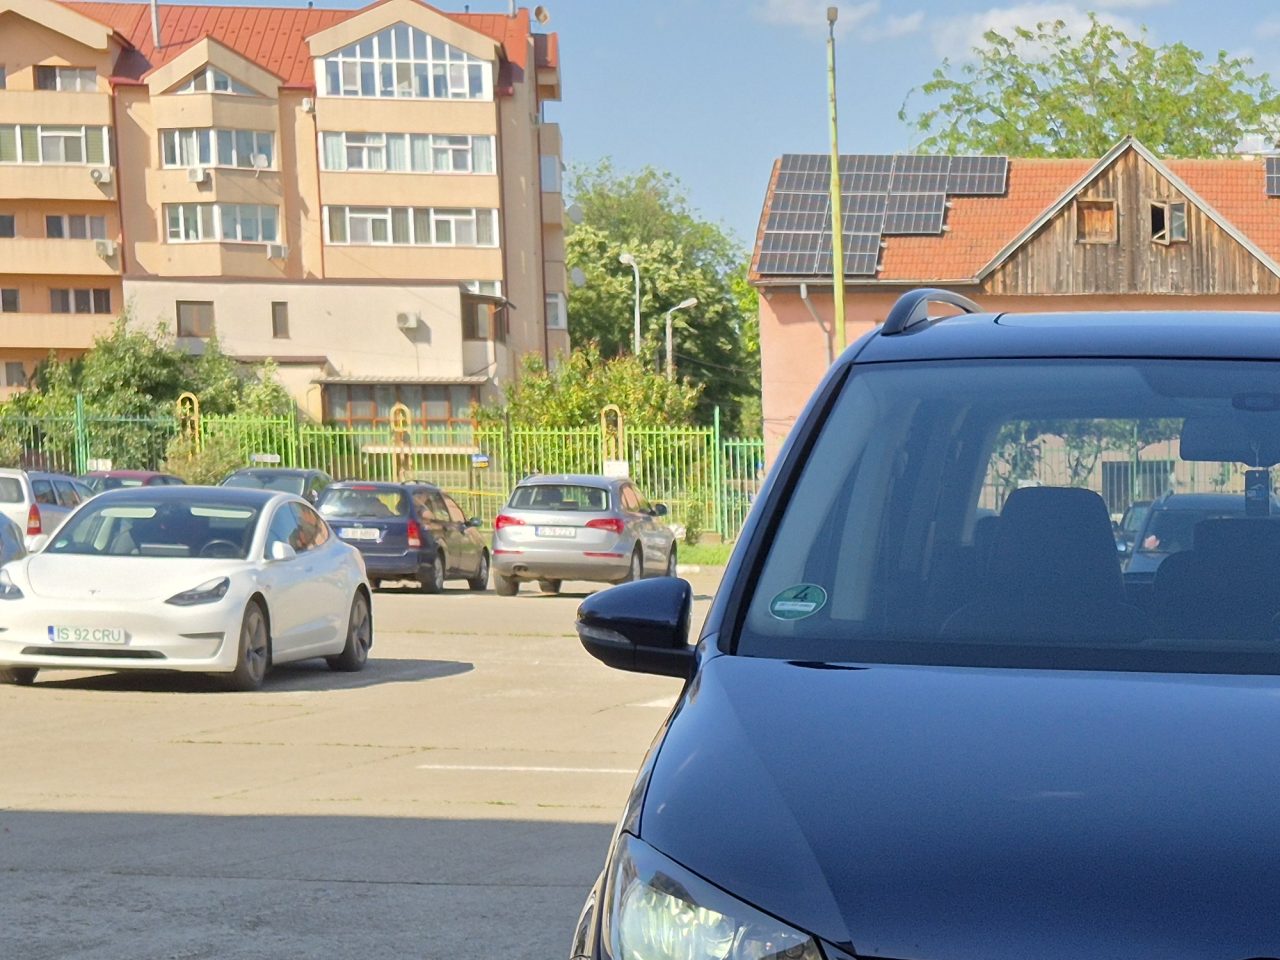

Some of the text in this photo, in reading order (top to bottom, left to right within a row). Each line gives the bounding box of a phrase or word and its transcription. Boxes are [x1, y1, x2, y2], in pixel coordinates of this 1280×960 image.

[791, 586, 811, 602] 4
[57, 627, 121, 642] IS 92 CRU
